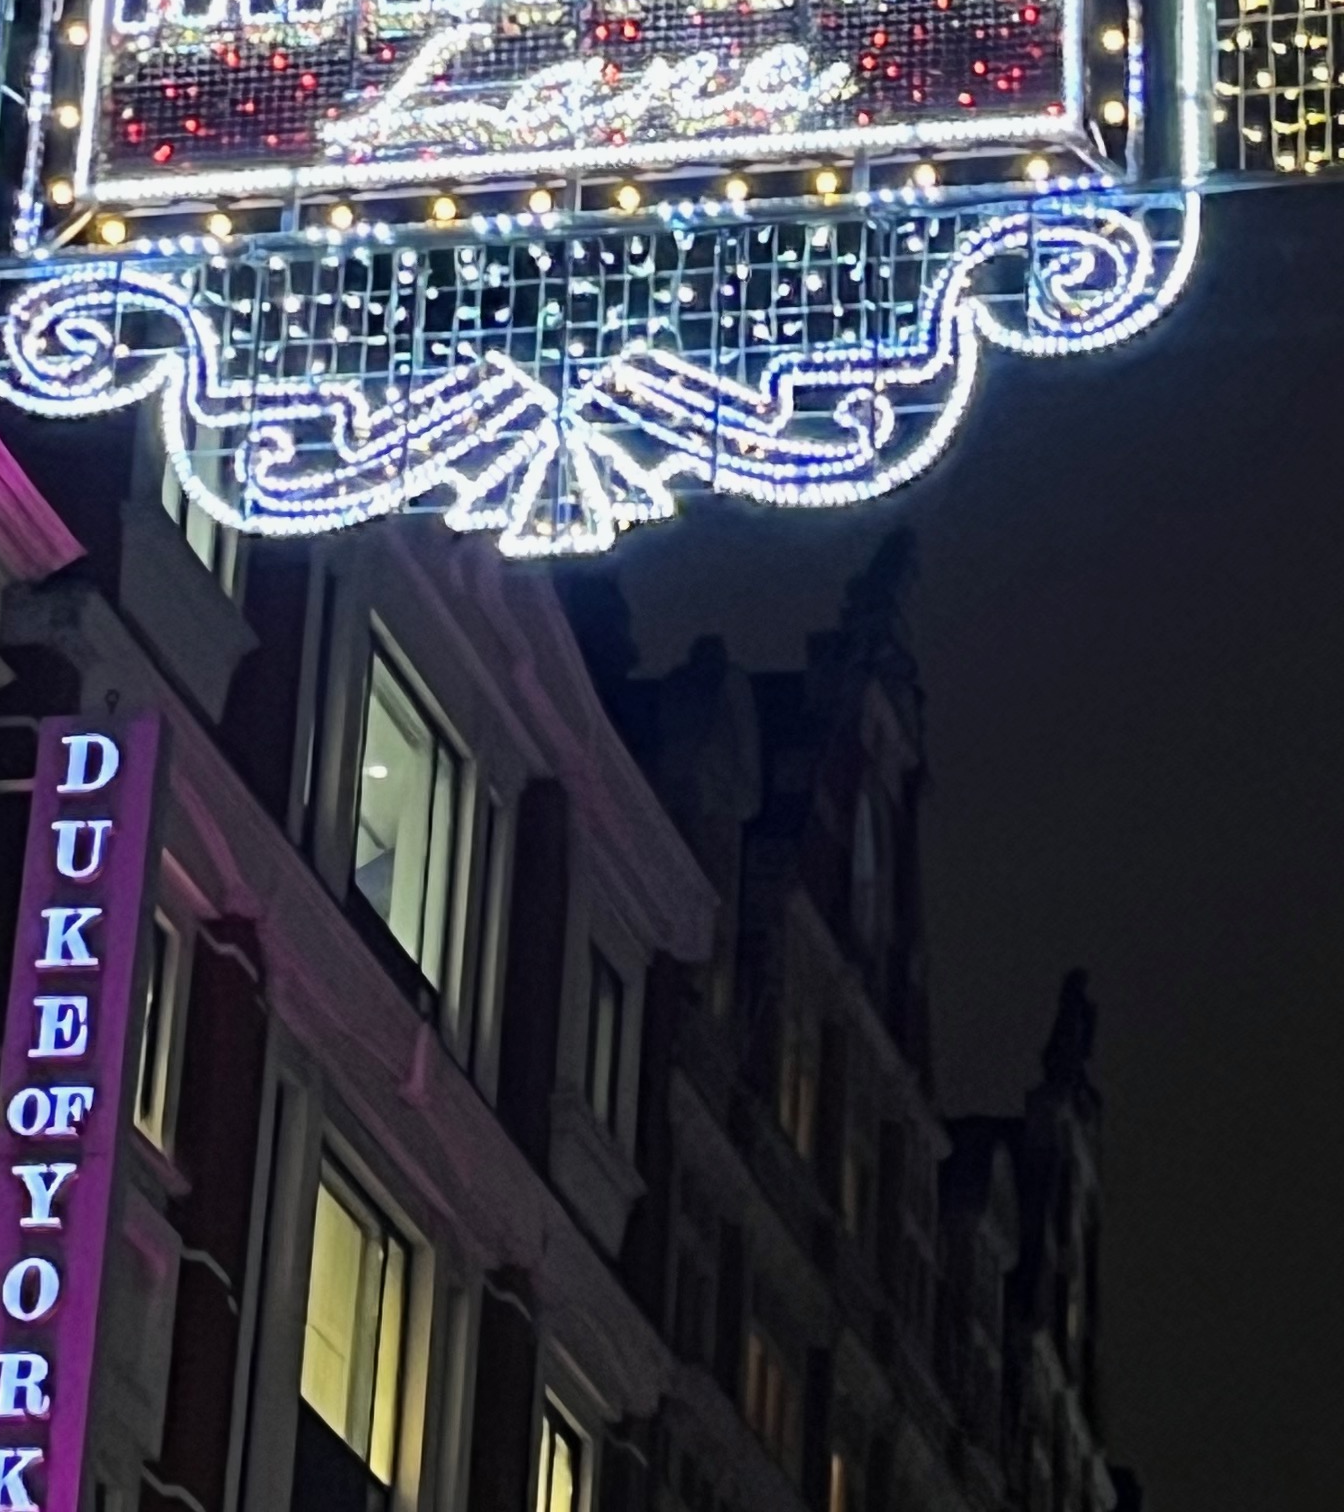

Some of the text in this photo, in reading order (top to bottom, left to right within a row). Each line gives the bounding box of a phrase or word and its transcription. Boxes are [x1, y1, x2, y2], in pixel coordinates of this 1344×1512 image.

[318, 22, 858, 154] Lane
[27, 732, 121, 1059] DUKE
[6, 1085, 94, 1137] OF
